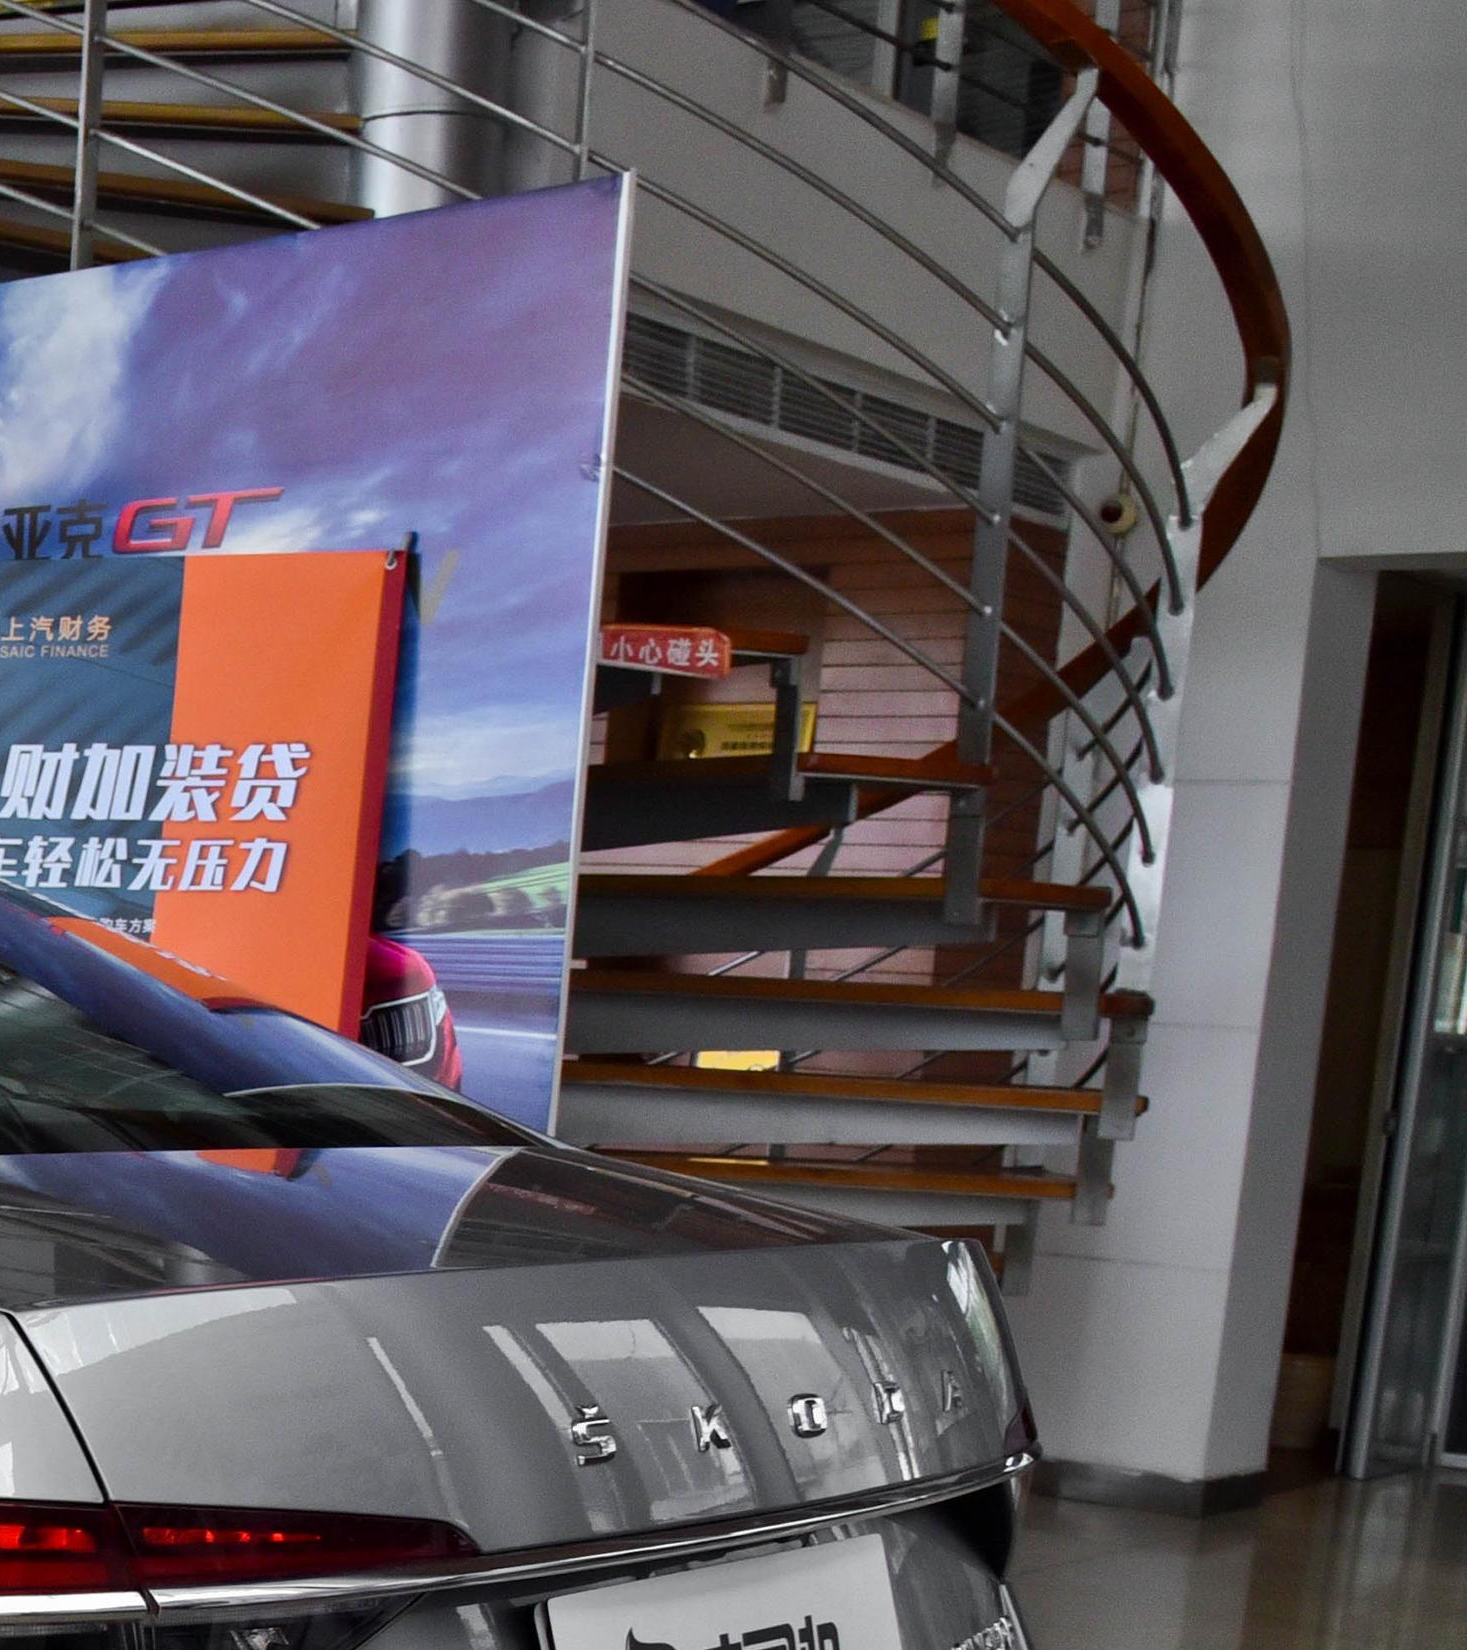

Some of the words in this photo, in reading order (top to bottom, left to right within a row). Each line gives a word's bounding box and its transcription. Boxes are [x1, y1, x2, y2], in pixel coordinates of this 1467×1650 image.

[112, 486, 284, 554] GT
[0, 614, 112, 643] 上汽财务
[0, 645, 35, 659] SAIC
[40, 644, 110, 659] FINANCE
[610, 634, 719, 668] 小心碰头
